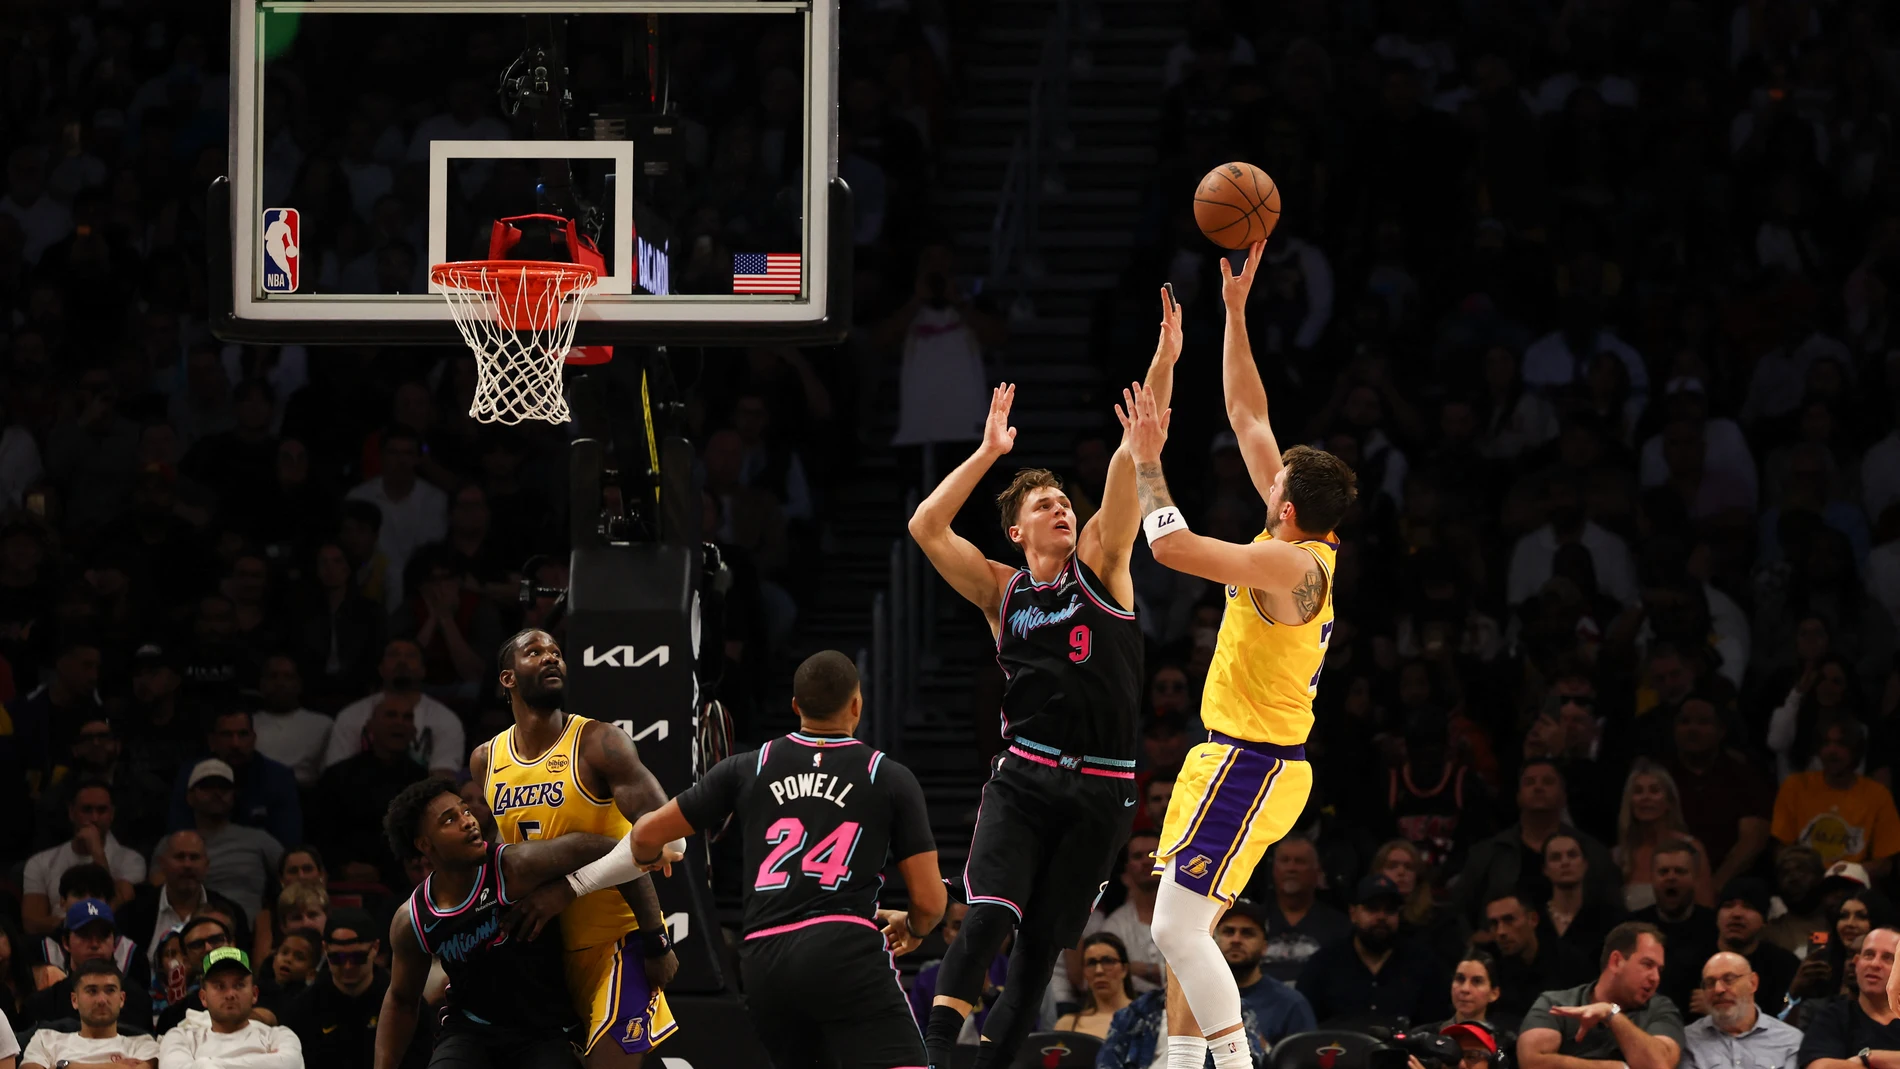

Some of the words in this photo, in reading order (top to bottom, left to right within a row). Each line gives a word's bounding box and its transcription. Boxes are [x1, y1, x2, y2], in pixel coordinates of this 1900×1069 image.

[267, 273, 285, 287] NBA
[1007, 593, 1085, 640] Miami
[583, 645, 670, 667] KIA
[1068, 624, 1092, 664] 9
[493, 780, 565, 816] LAKERS
[769, 772, 854, 808] POWELL
[754, 817, 863, 891] 24
[435, 907, 499, 963] Miami
